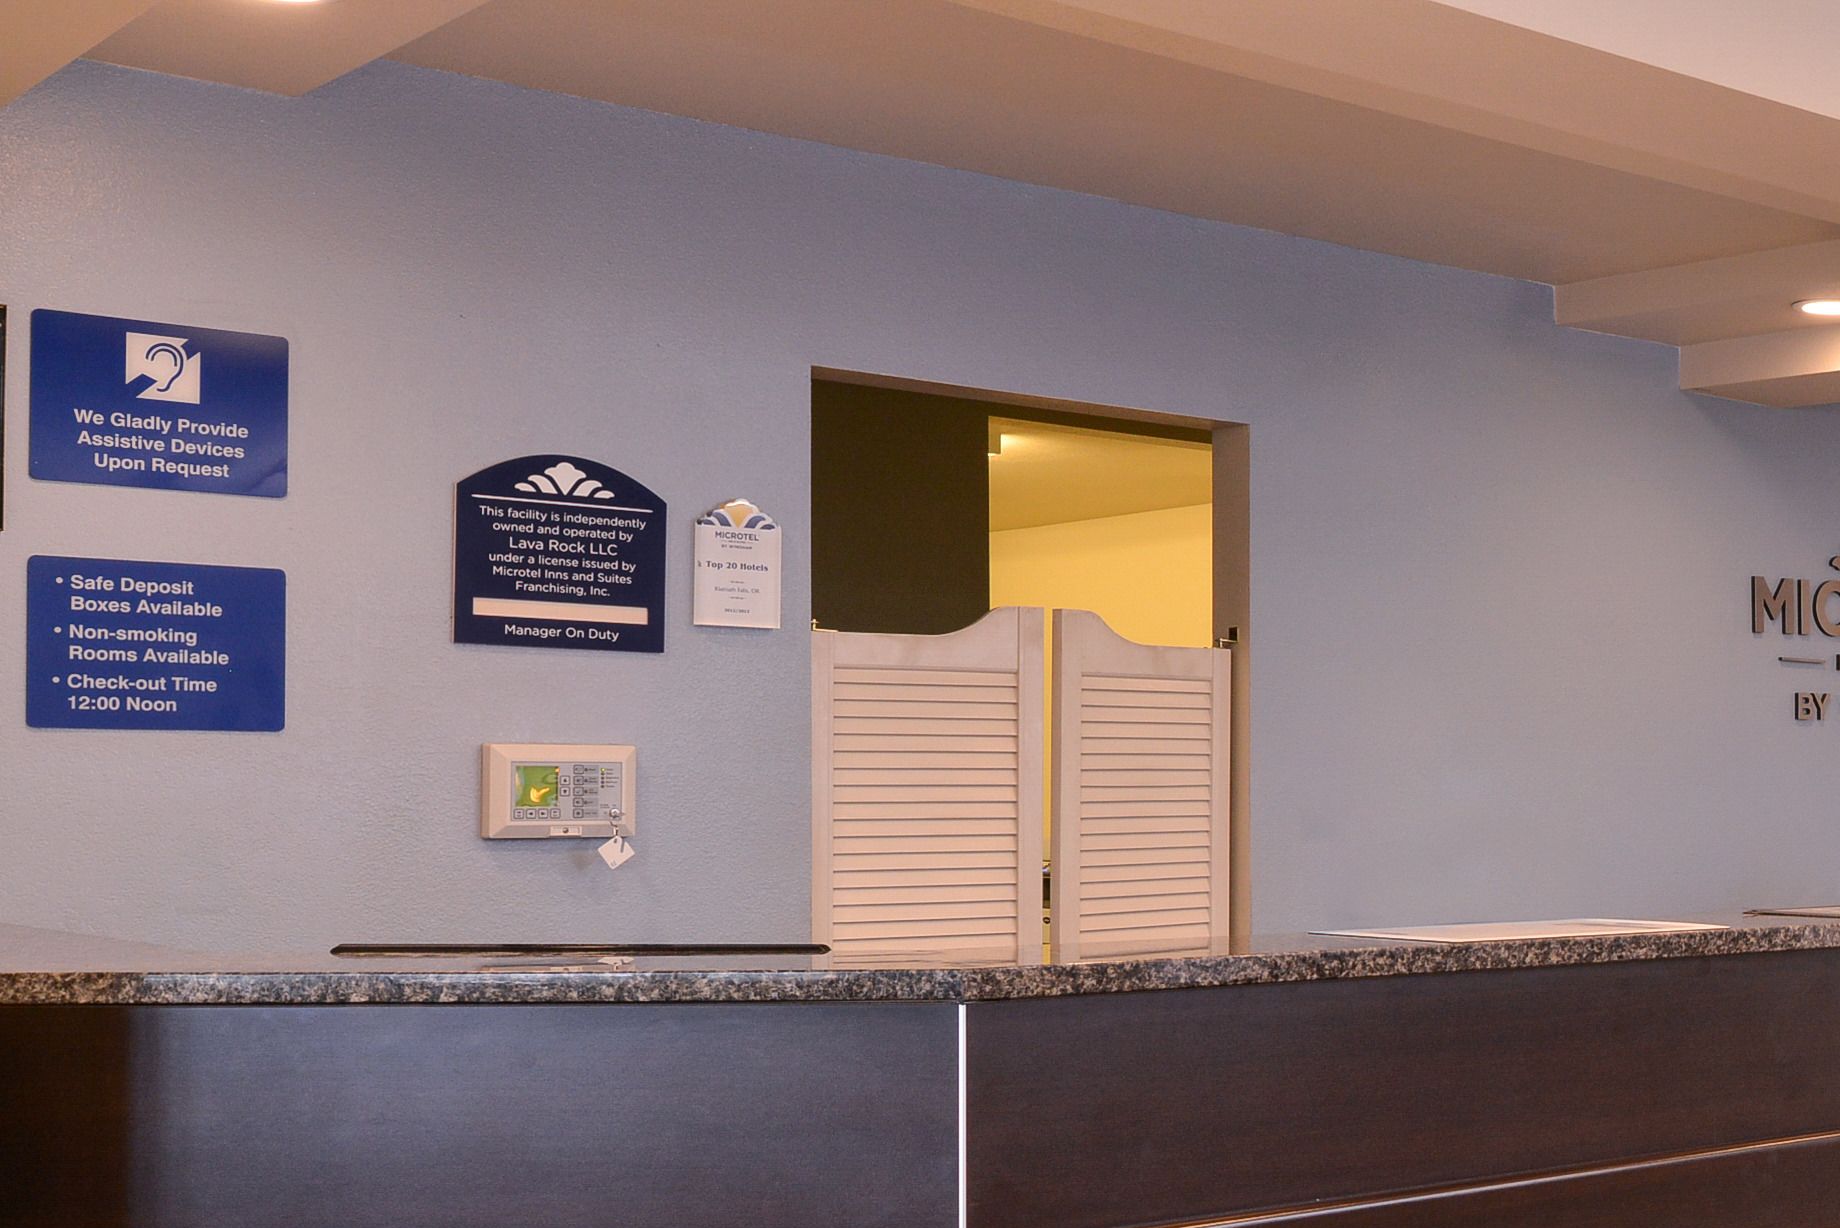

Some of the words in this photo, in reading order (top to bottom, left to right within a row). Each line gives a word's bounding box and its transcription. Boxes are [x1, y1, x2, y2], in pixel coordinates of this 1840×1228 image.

[74, 409, 104, 425] We
[110, 412, 171, 434] Gladly
[178, 419, 249, 438] Provide
[77, 431, 165, 451] Assistive
[171, 439, 245, 458] Devices
[94, 453, 145, 471] Upon
[152, 458, 229, 477] Request
[479, 505, 504, 517] This
[507, 507, 547, 522] facility
[551, 511, 560, 521] is
[564, 512, 647, 531] independently
[492, 522, 534, 533] owned
[537, 525, 560, 535] and
[563, 527, 616, 540] operated
[619, 530, 633, 542] by
[715, 531, 759, 541] MICROTEL
[509, 537, 544, 550] Lava
[548, 539, 585, 554] Rock
[590, 543, 618, 556] LLC
[489, 553, 524, 563] under
[527, 556, 535, 564] a
[538, 554, 579, 567] license
[582, 557, 618, 570] issued
[622, 560, 636, 573] by
[706, 560, 723, 570] Top
[726, 561, 738, 570] 20
[740, 562, 768, 572] Hotels
[492, 566, 541, 578] Microtel
[545, 569, 569, 580] Inns
[572, 571, 594, 582] and
[597, 573, 632, 585] Suites
[70, 575, 114, 591] Safe
[120, 577, 194, 597] Deposit
[515, 581, 587, 597] Franchising,
[590, 586, 610, 597] Inc.
[71, 596, 131, 612] Boxes
[136, 599, 223, 617] Available
[69, 624, 197, 646] Non-smoking
[504, 624, 561, 639] Manager
[565, 627, 585, 639] On
[588, 628, 619, 642] Duty
[69, 645, 137, 661] Rooms
[143, 648, 229, 665] Available
[67, 674, 166, 691] Check-out
[171, 677, 217, 692] Time
[68, 696, 120, 710] 12:00
[126, 697, 177, 712] Noon
[1794, 692, 1830, 720] BY
